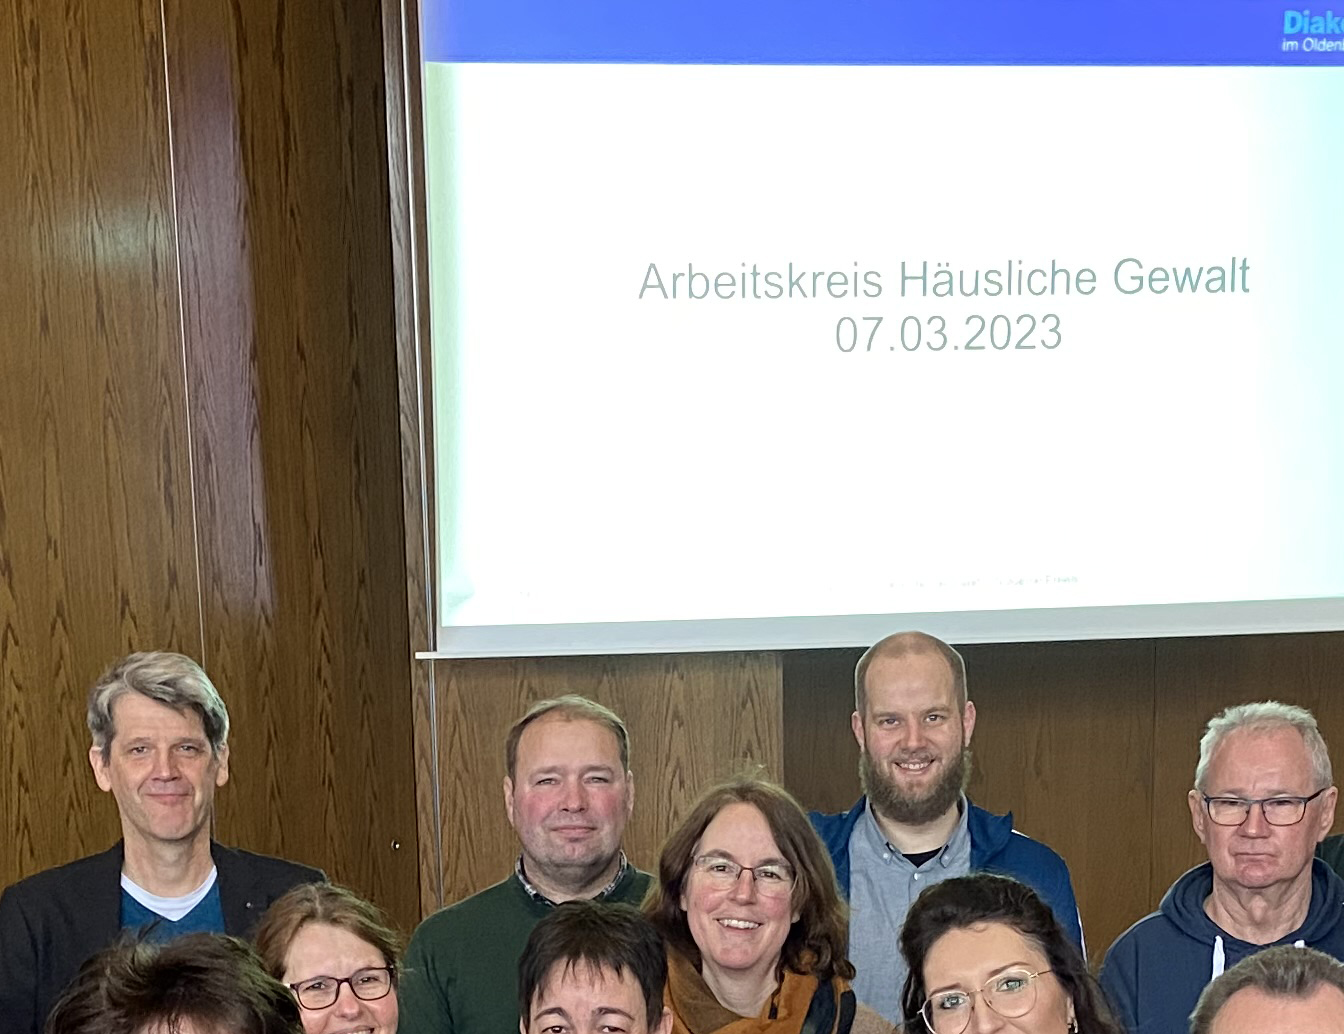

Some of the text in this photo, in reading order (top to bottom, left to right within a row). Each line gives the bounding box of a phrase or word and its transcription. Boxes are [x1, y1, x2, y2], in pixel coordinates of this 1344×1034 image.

[1282, 38, 1299, 51] im
[638, 257, 1251, 299] Arbeitskreis Häusliche Gewalt
[835, 313, 1063, 353] 07.03.2023
